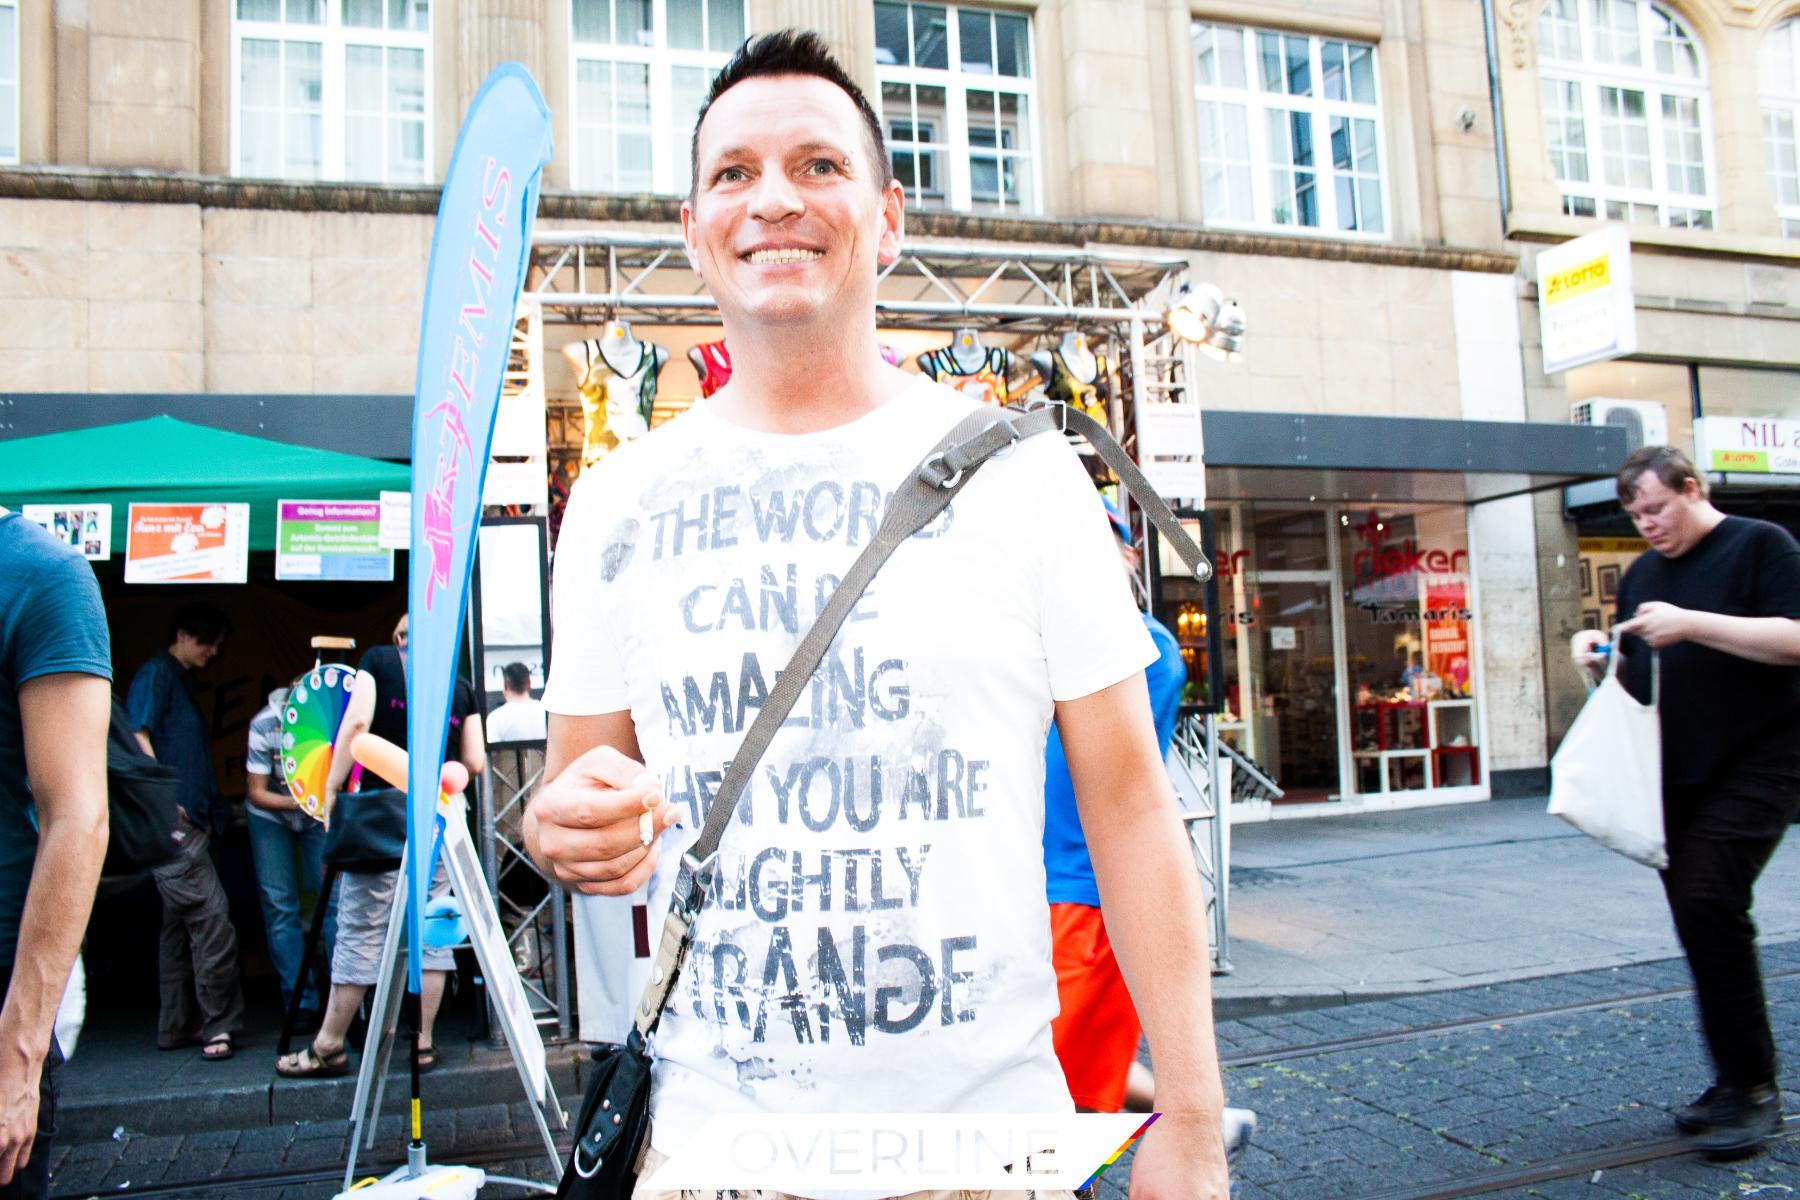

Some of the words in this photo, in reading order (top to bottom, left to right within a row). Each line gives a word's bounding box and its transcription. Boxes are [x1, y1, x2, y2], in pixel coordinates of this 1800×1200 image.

[1564, 262, 1606, 289] LOTTO
[1742, 422, 1784, 447] NIL
[650, 485, 741, 561] THE
[1352, 538, 1468, 579] rieker
[679, 563, 799, 634] CAN
[1362, 600, 1472, 624] Tamaris
[659, 646, 911, 737] AMAING
[765, 756, 882, 833] YOU
[898, 749, 990, 822] ARE
